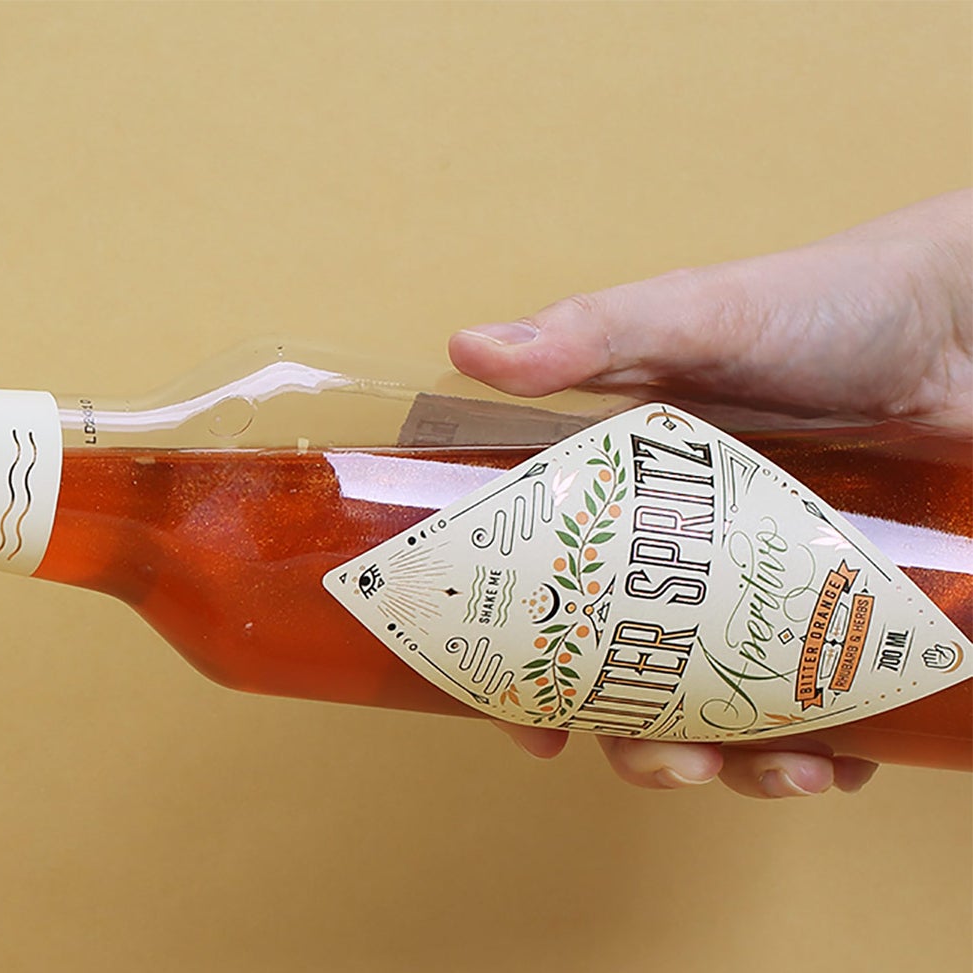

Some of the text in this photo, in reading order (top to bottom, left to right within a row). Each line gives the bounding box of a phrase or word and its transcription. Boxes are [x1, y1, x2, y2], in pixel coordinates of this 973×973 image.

[626, 433, 715, 606] SPRITZ
[478, 569, 502, 624] SHAKE ME
[697, 516, 817, 731] Aperitivo
[800, 579, 841, 695] BITTER ORANGE
[835, 598, 870, 688] RHUBARB & HERBS
[877, 629, 909, 672] 700 ML
